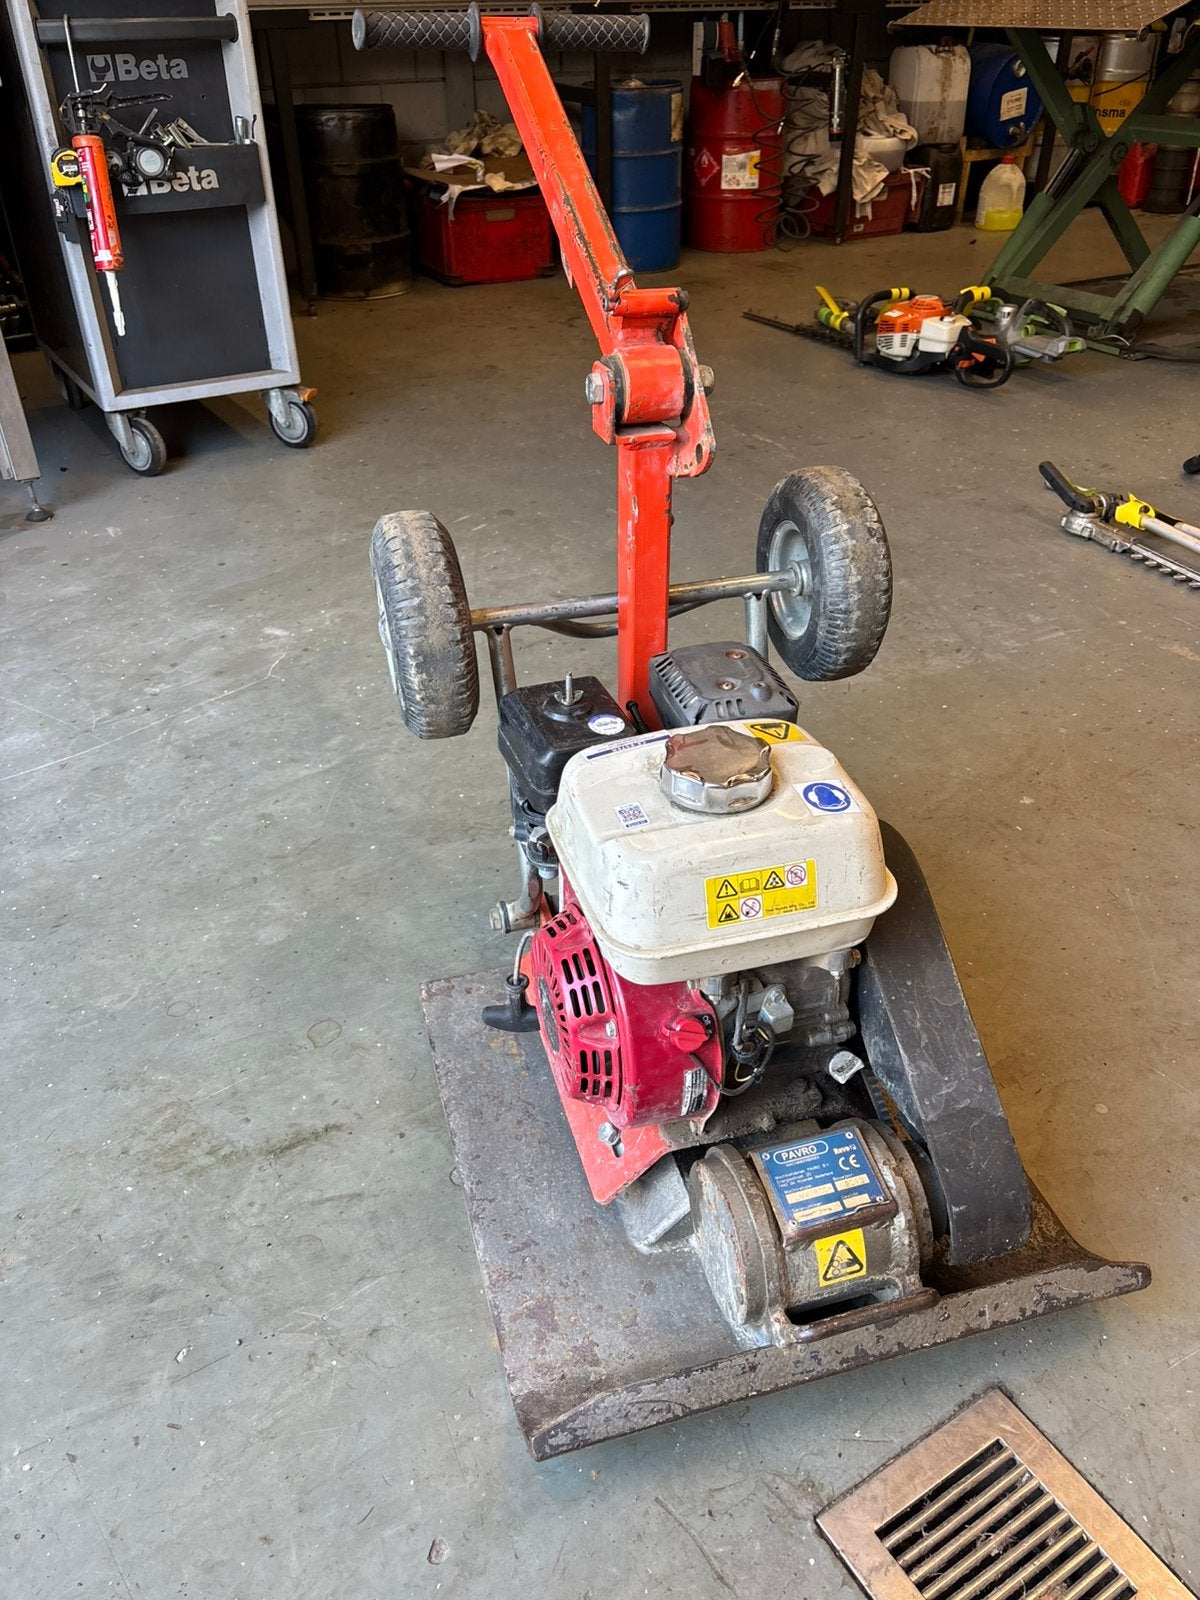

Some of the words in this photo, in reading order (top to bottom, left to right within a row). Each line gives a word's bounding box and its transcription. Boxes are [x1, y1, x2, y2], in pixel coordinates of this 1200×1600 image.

[114, 53, 190, 81] Beta
[150, 165, 220, 195] Beta
[781, 1146, 817, 1160] PAVRO
[839, 1154, 860, 1170] CE
